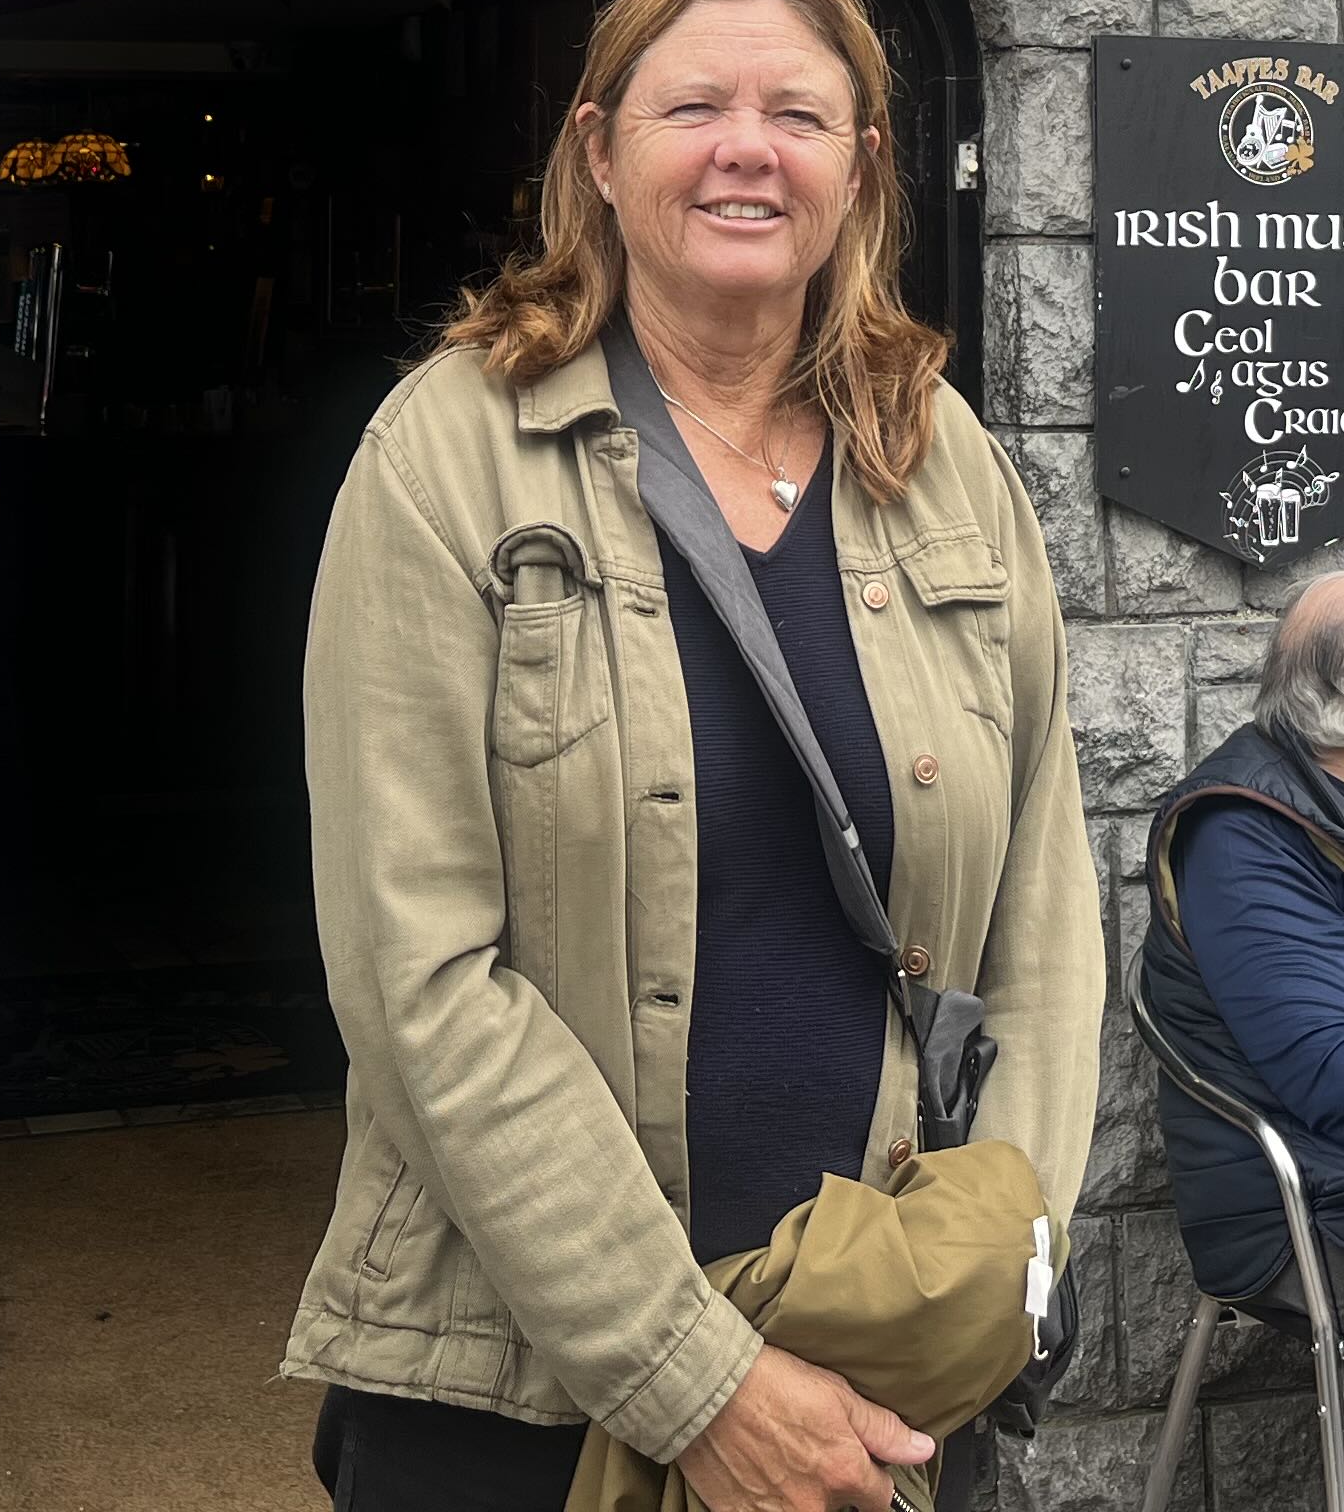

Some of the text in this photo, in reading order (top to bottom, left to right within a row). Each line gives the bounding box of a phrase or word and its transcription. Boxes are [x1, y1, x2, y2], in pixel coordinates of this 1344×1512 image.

[1189, 57, 1340, 105] TAAFFES BAR
[1173, 309, 1273, 357] Ceol
